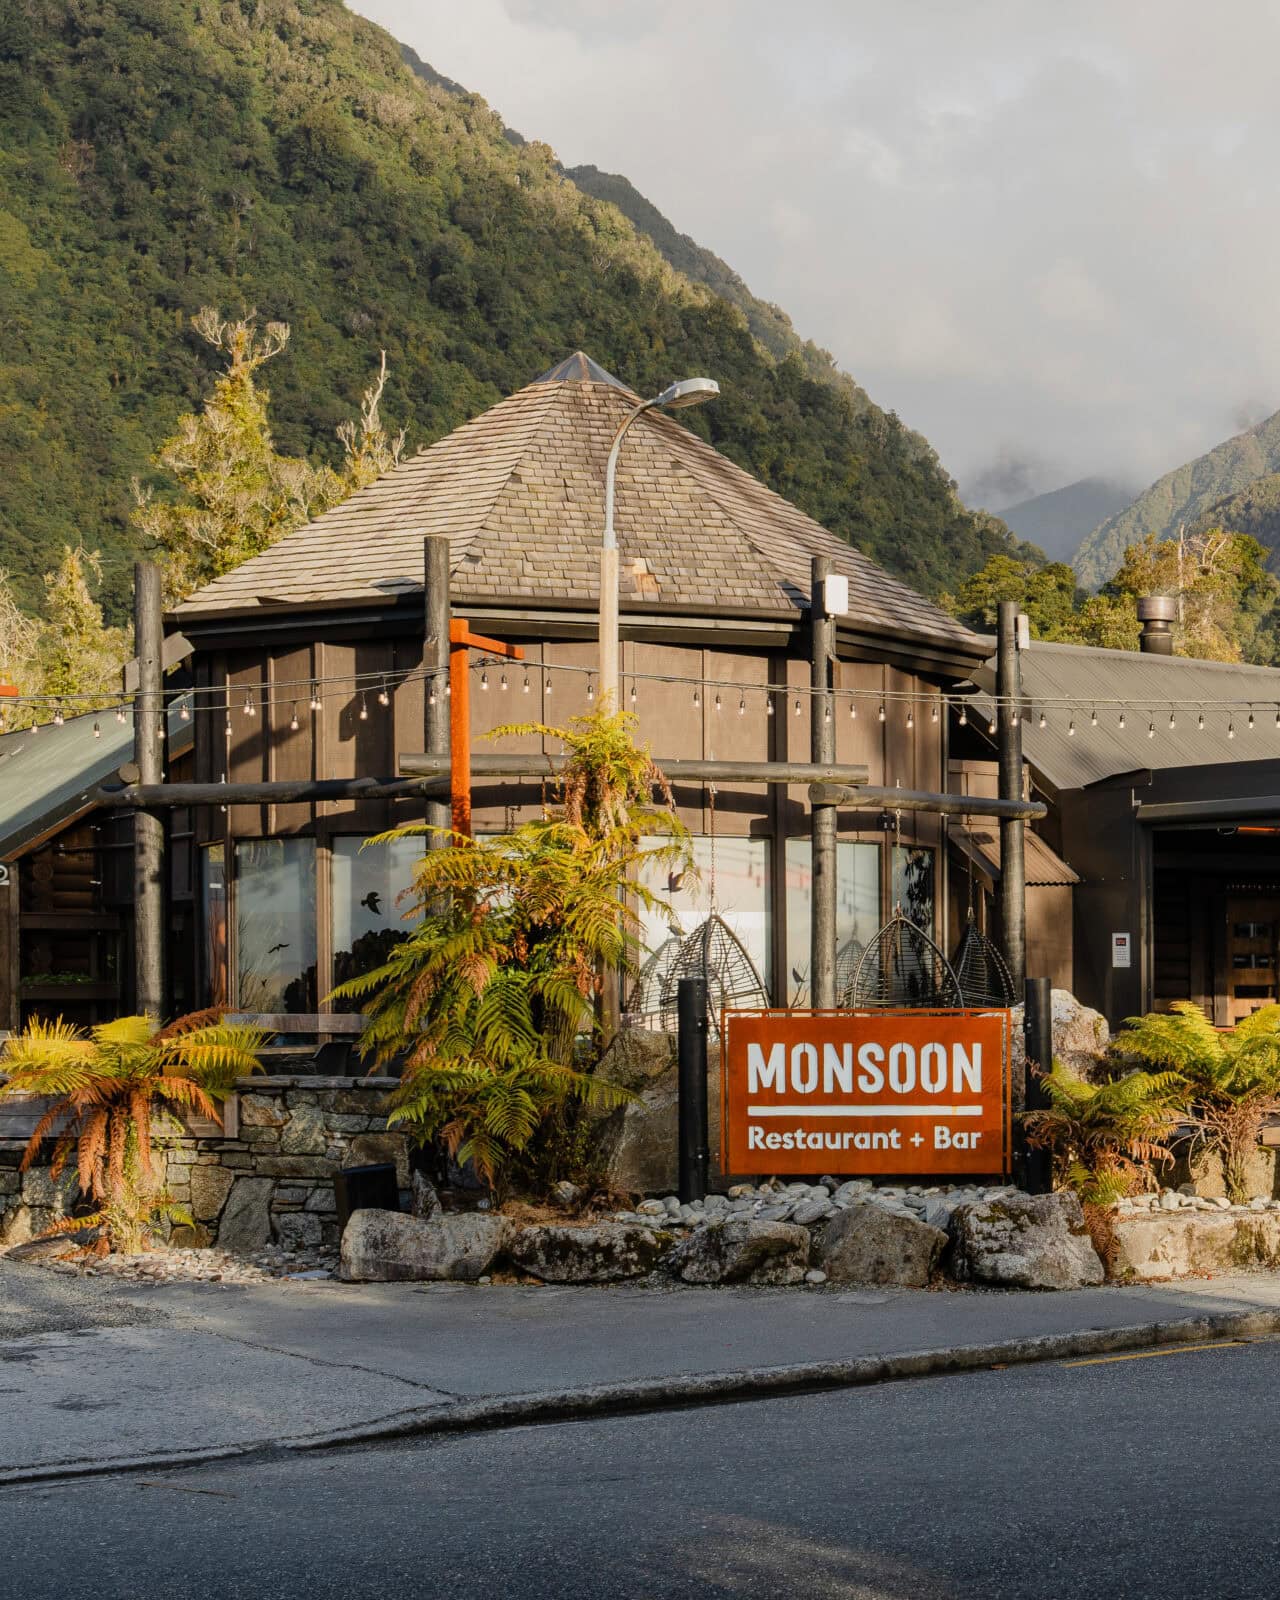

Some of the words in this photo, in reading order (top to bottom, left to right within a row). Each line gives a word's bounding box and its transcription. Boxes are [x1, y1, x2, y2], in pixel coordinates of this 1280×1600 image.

[747, 1042, 982, 1093] MONSOON
[748, 1126, 901, 1150] Restaurant
[909, 1132, 925, 1148] +
[934, 1125, 982, 1149] Bar
